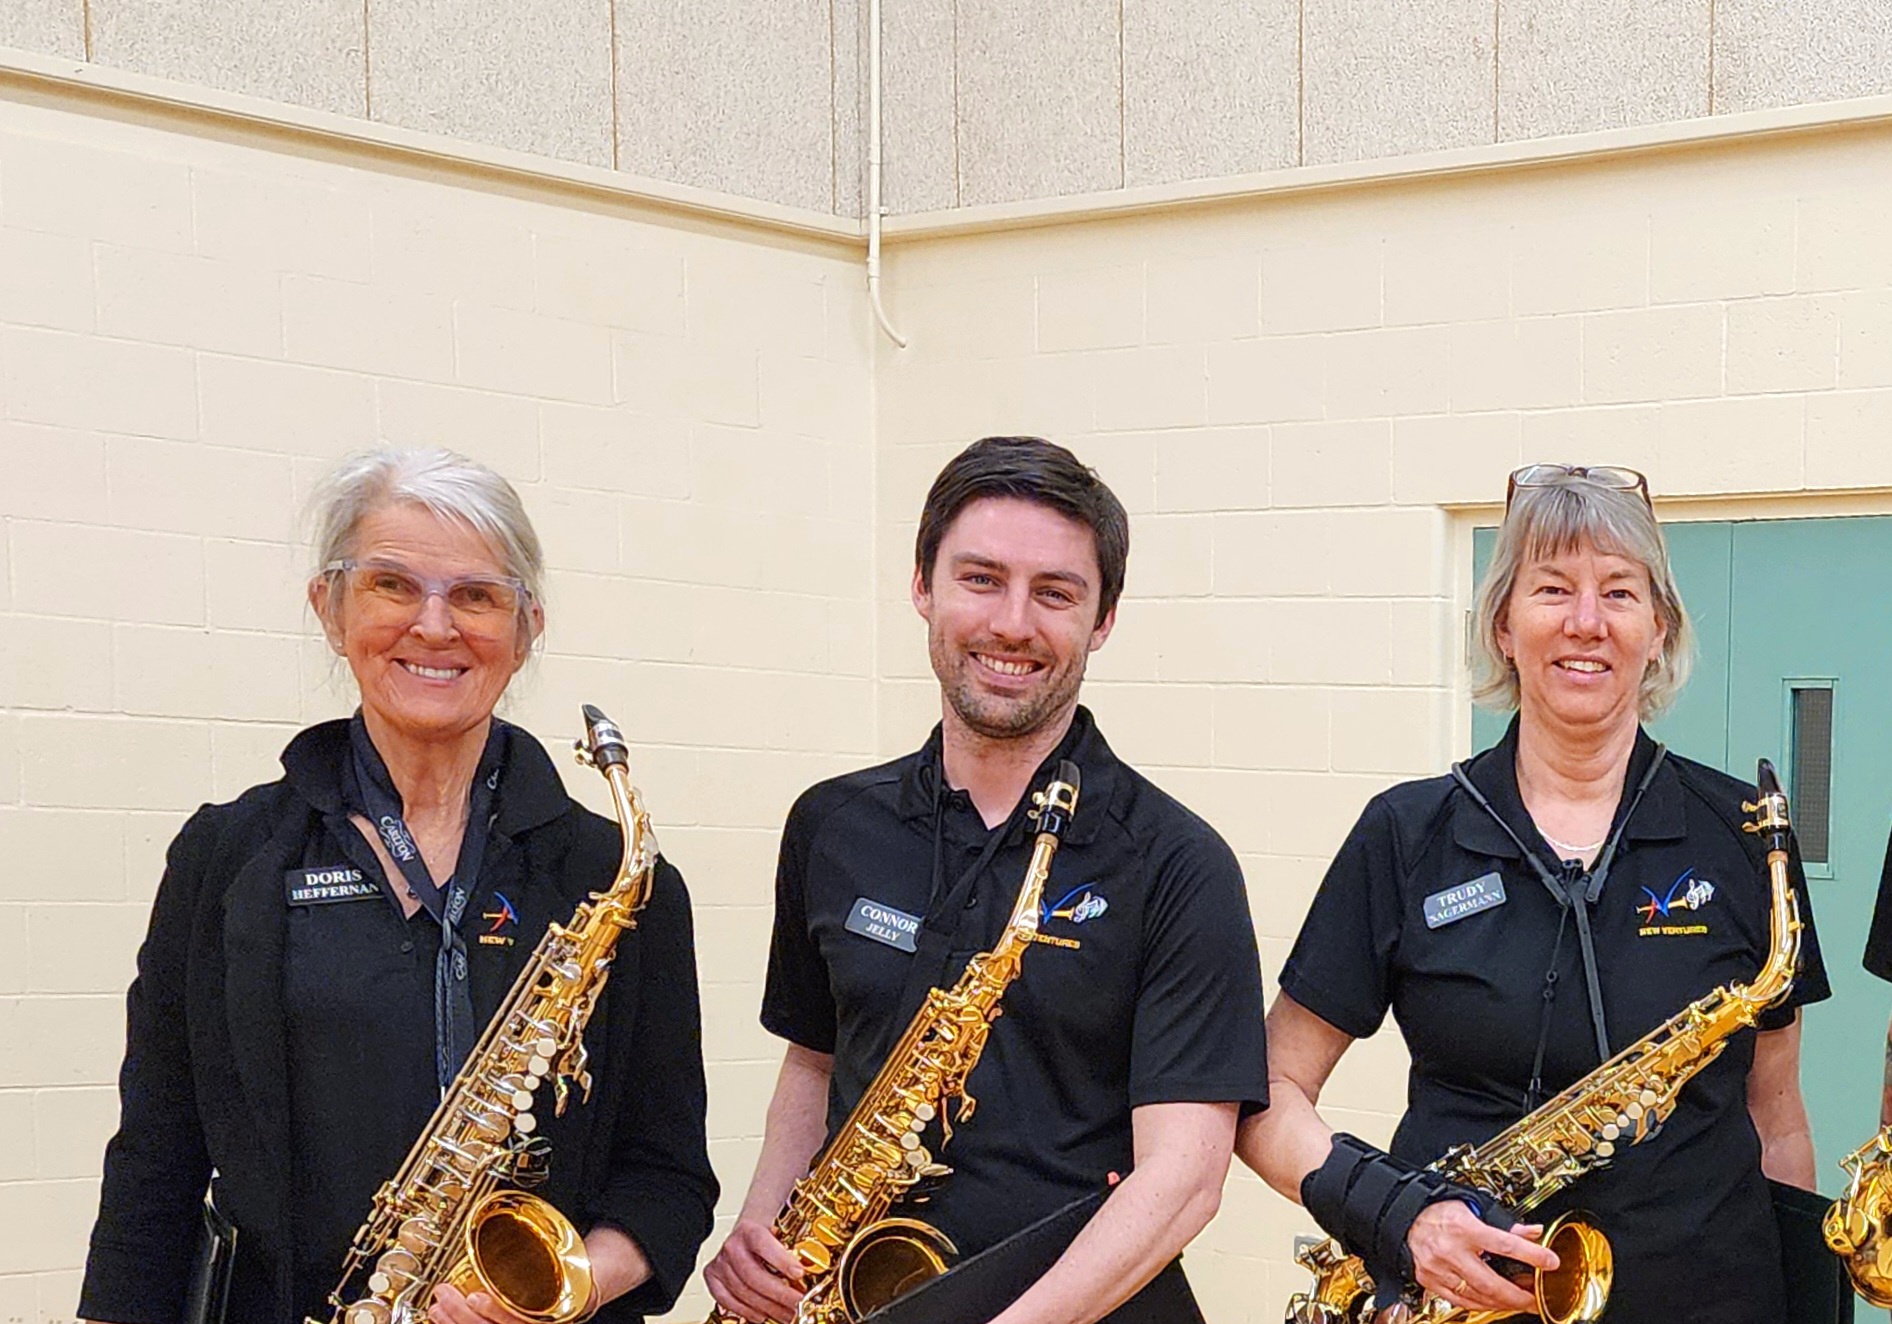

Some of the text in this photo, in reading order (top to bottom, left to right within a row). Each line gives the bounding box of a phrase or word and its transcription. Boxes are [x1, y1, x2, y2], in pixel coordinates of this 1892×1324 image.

[379, 816, 415, 862] CARLTON
[305, 868, 362, 886] DORIS
[292, 881, 379, 901] HEFFERNAN
[1436, 880, 1485, 907] TRUDY
[860, 904, 919, 934] CONNOR
[479, 935, 507, 945] NEW
[865, 923, 900, 942] JELLY
[1639, 926, 1660, 936] NEW
